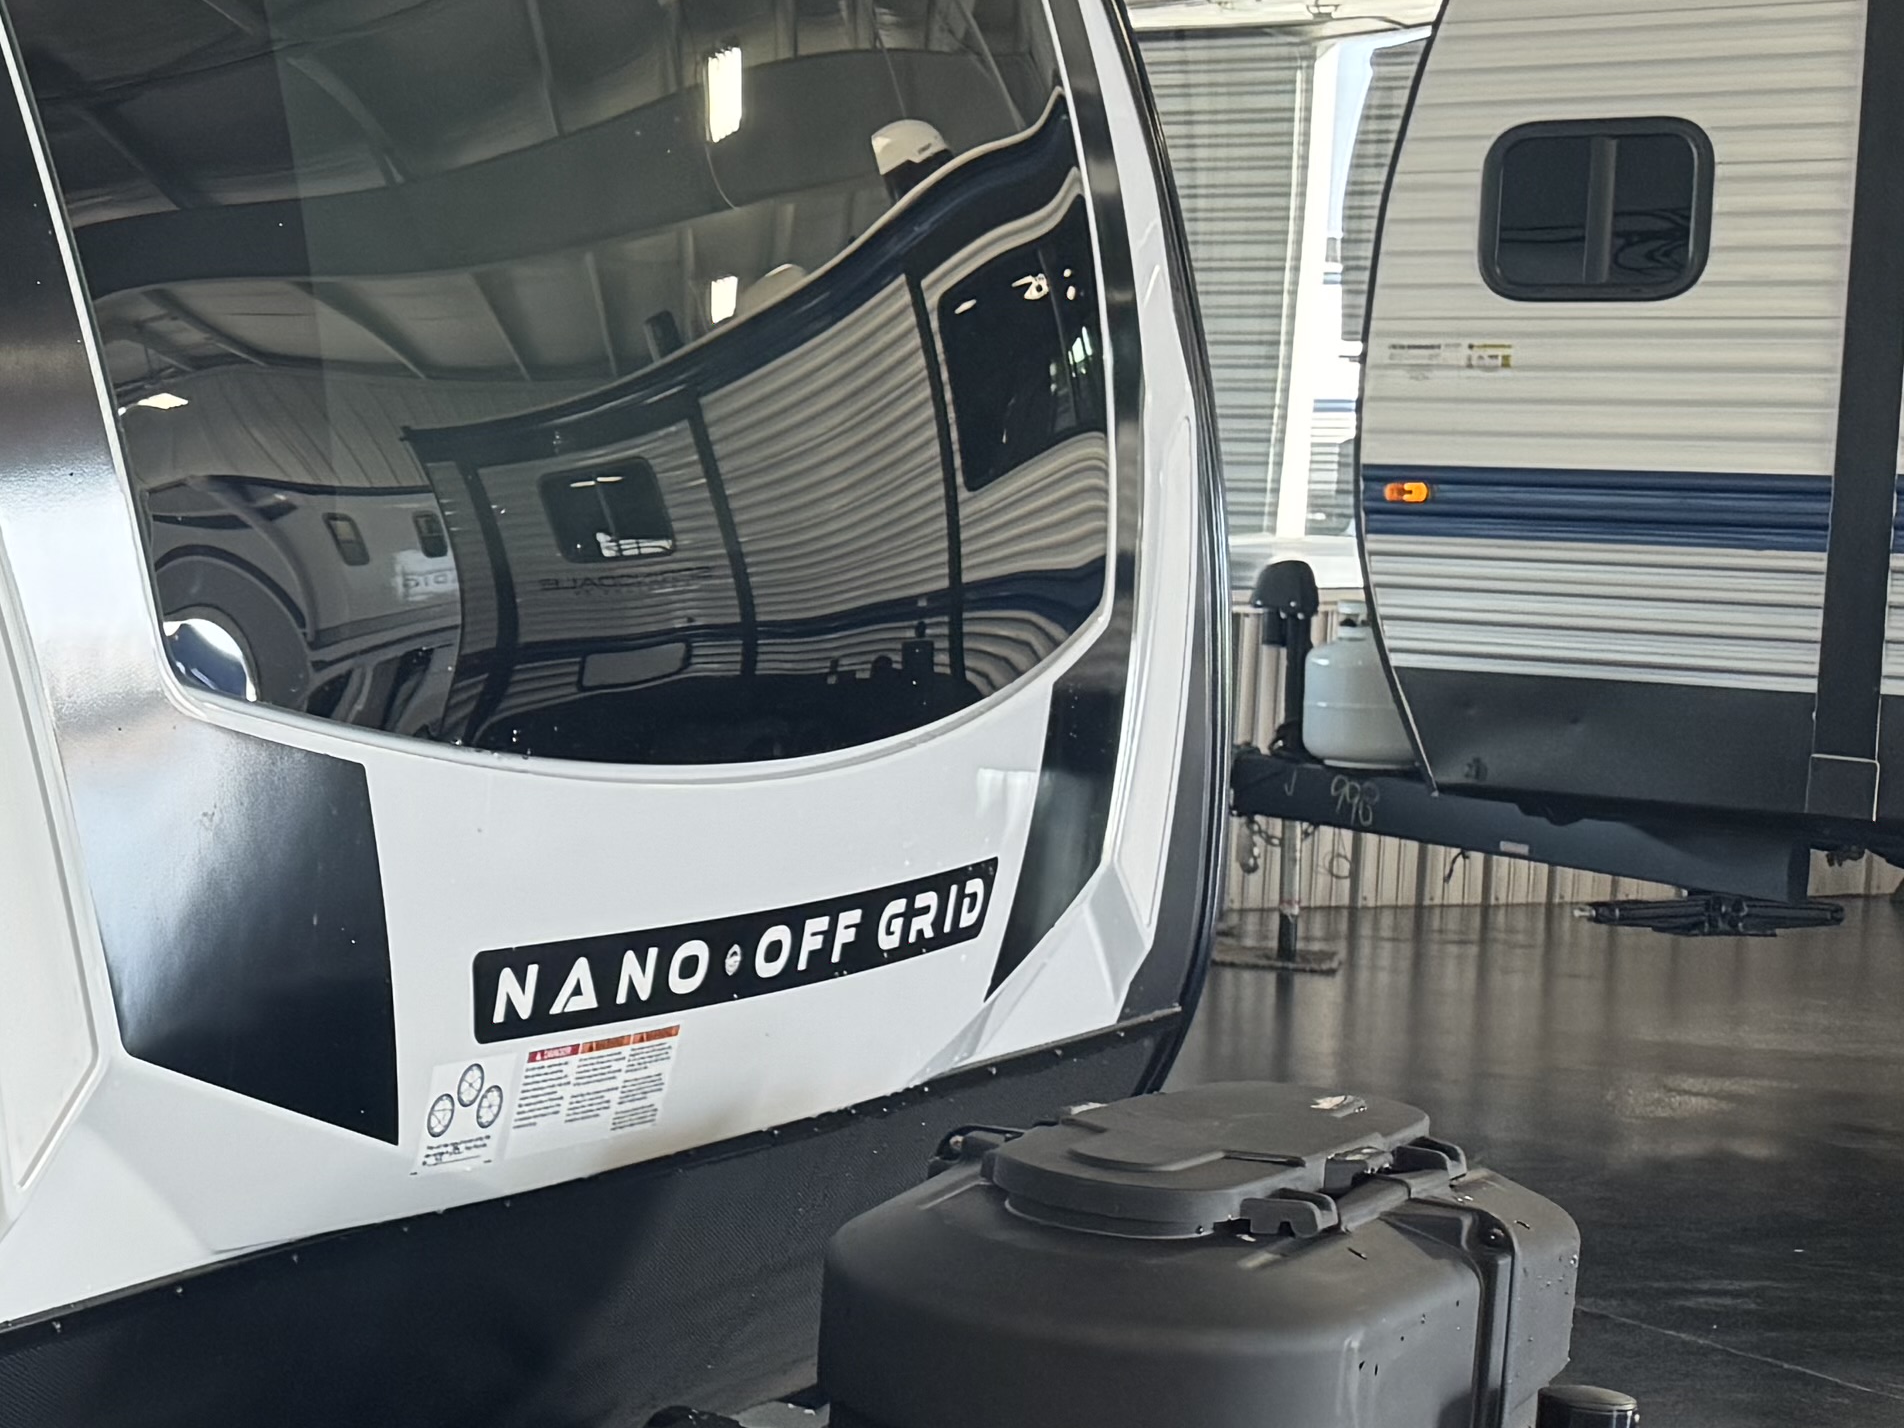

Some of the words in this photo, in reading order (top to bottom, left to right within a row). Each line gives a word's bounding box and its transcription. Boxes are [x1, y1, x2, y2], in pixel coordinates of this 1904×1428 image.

[492, 939, 710, 1024] NANO
[755, 909, 863, 978] OFF
[878, 877, 985, 952] GRID
